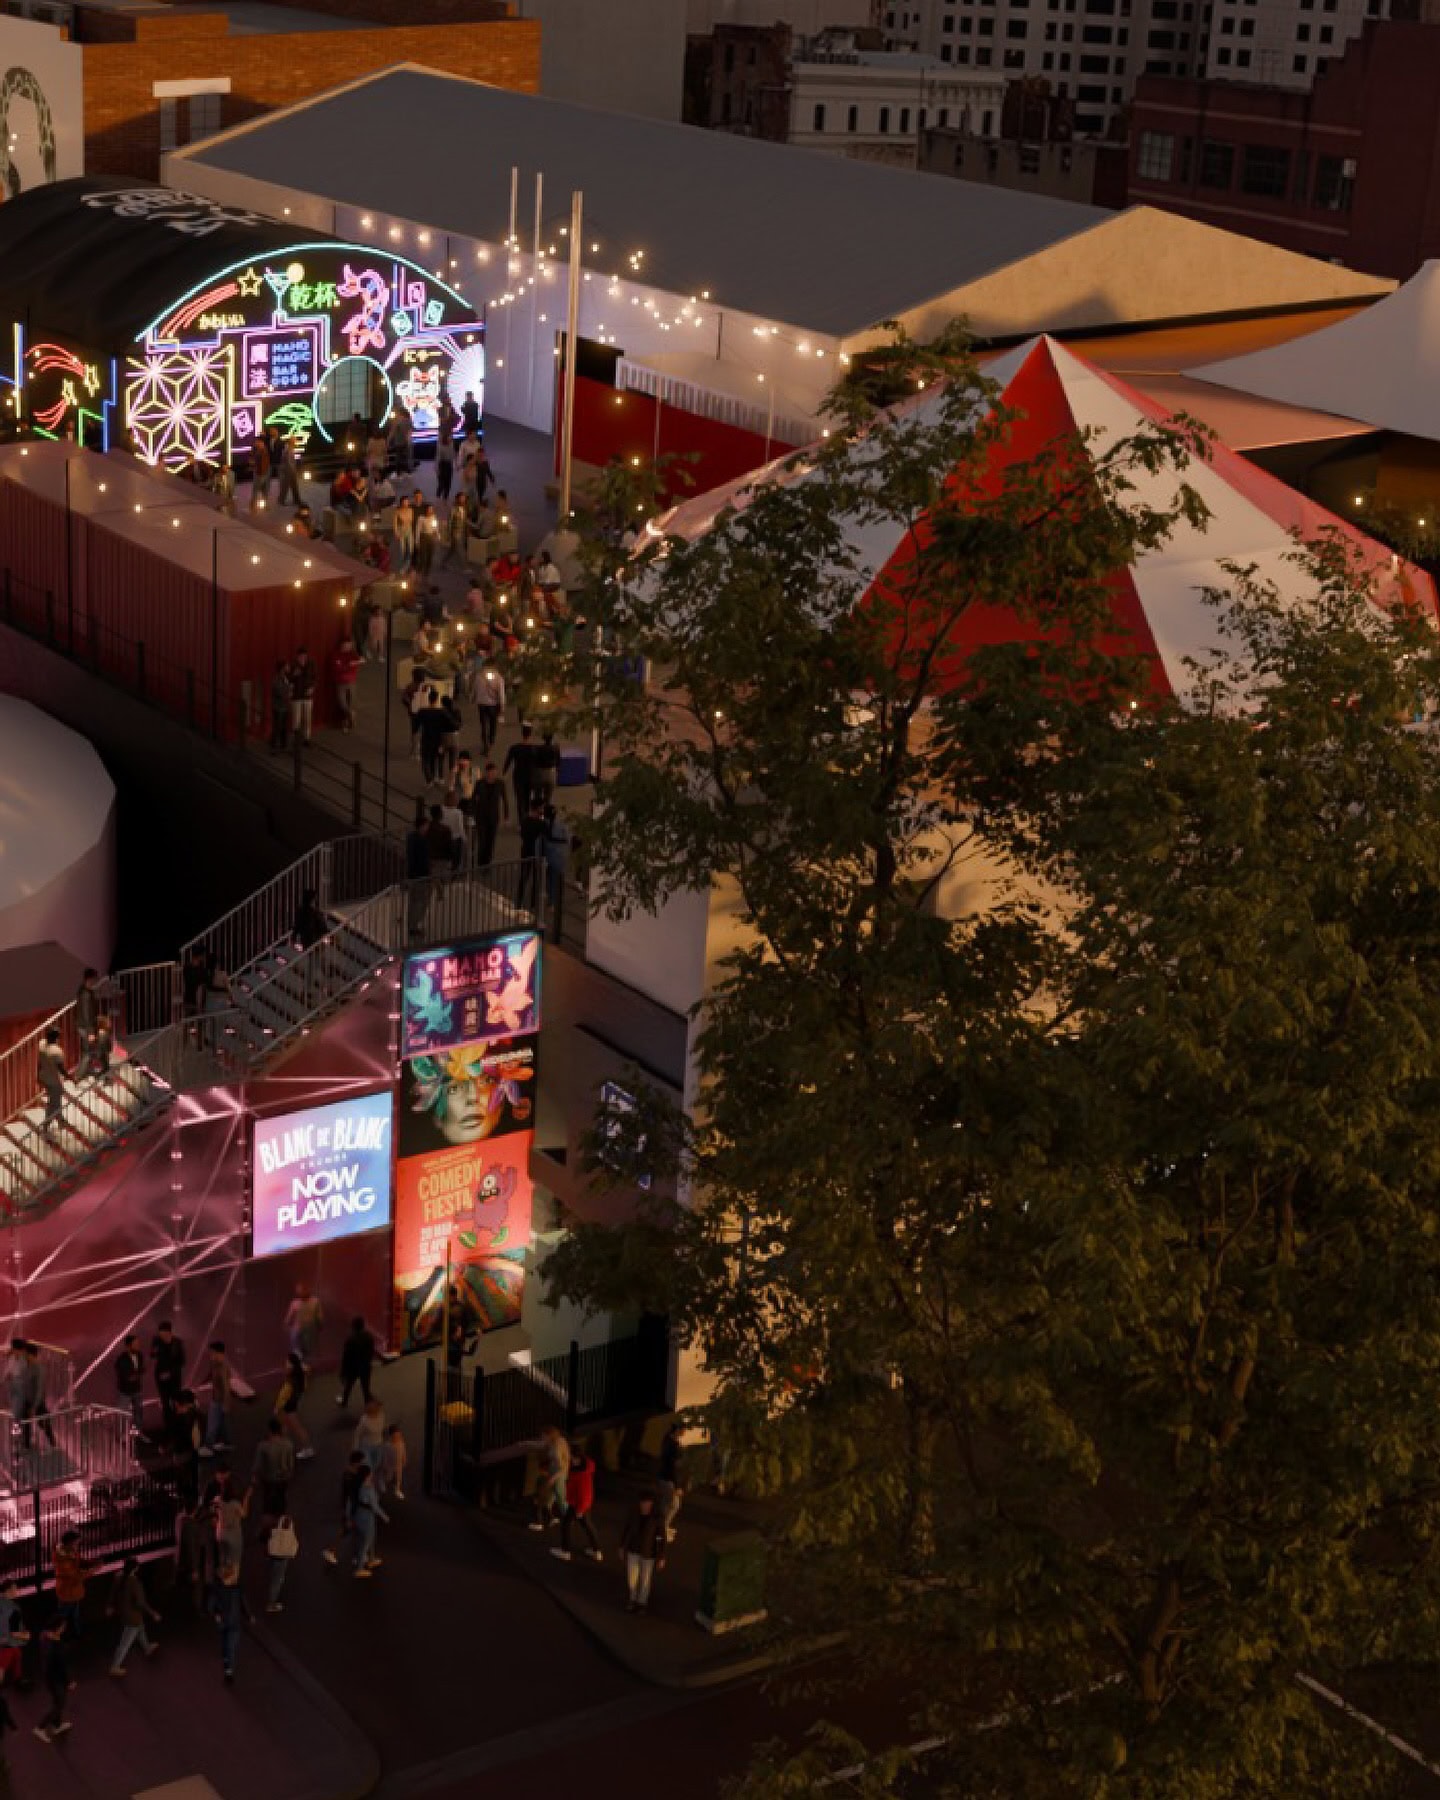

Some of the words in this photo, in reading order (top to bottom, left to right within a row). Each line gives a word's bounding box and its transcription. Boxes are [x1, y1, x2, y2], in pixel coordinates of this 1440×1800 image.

[290, 283, 336, 312] 乾杯
[258, 1122, 314, 1174] BLANC
[333, 1116, 389, 1151] BLANC
[292, 1164, 359, 1201] NOW
[418, 1157, 483, 1201] COMEDY
[277, 1187, 376, 1232] PLAYING
